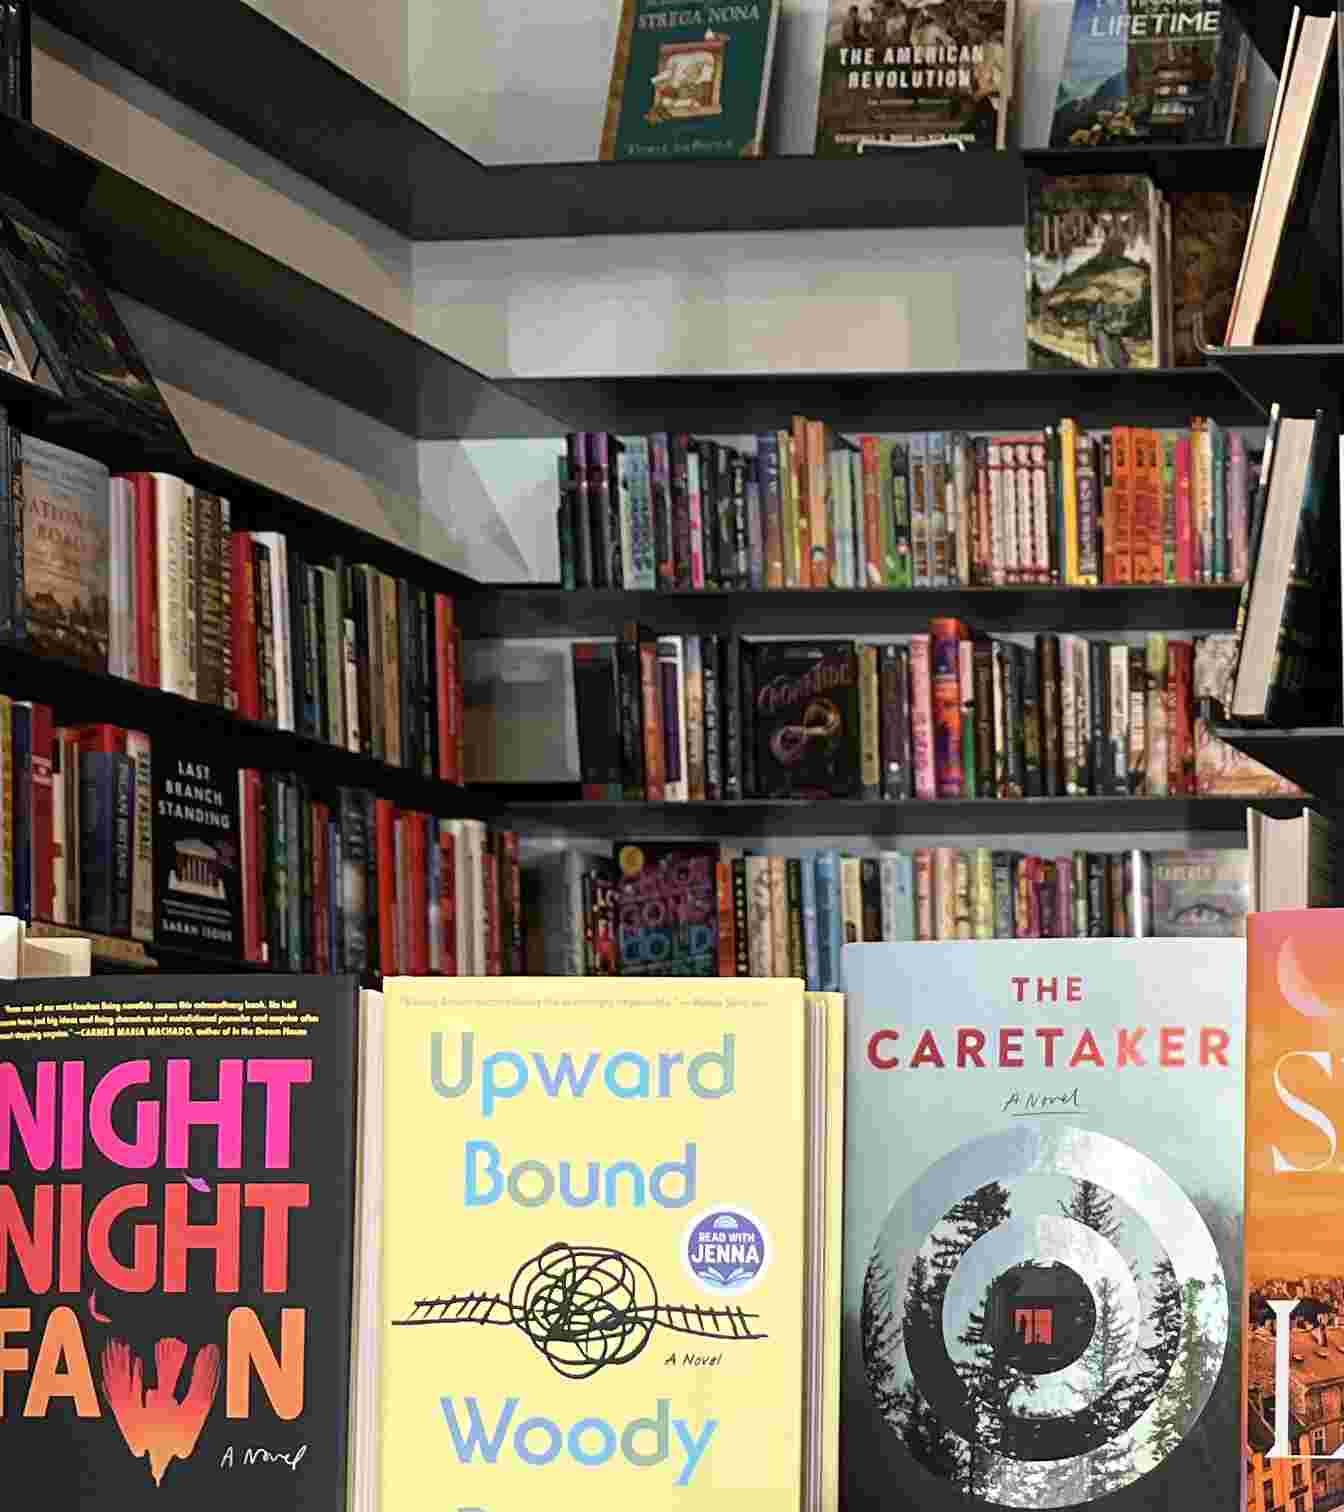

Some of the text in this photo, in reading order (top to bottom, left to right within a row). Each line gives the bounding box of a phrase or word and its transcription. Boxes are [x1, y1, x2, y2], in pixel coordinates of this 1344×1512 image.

[1091, 12, 1220, 36] LIFETIME
[840, 45, 983, 65] THE AMERICAN
[850, 70, 971, 90] REVOLUTION
[178, 760, 209, 780] LAST
[165, 778, 221, 807] BRANCH
[159, 799, 230, 829] STANDING
[1012, 977, 1084, 1004] THE
[866, 1025, 1232, 1069] CARETAKER
[430, 1031, 737, 1117] Upward
[464, 1140, 698, 1209] Bound
[441, 1396, 722, 1487] Woody
